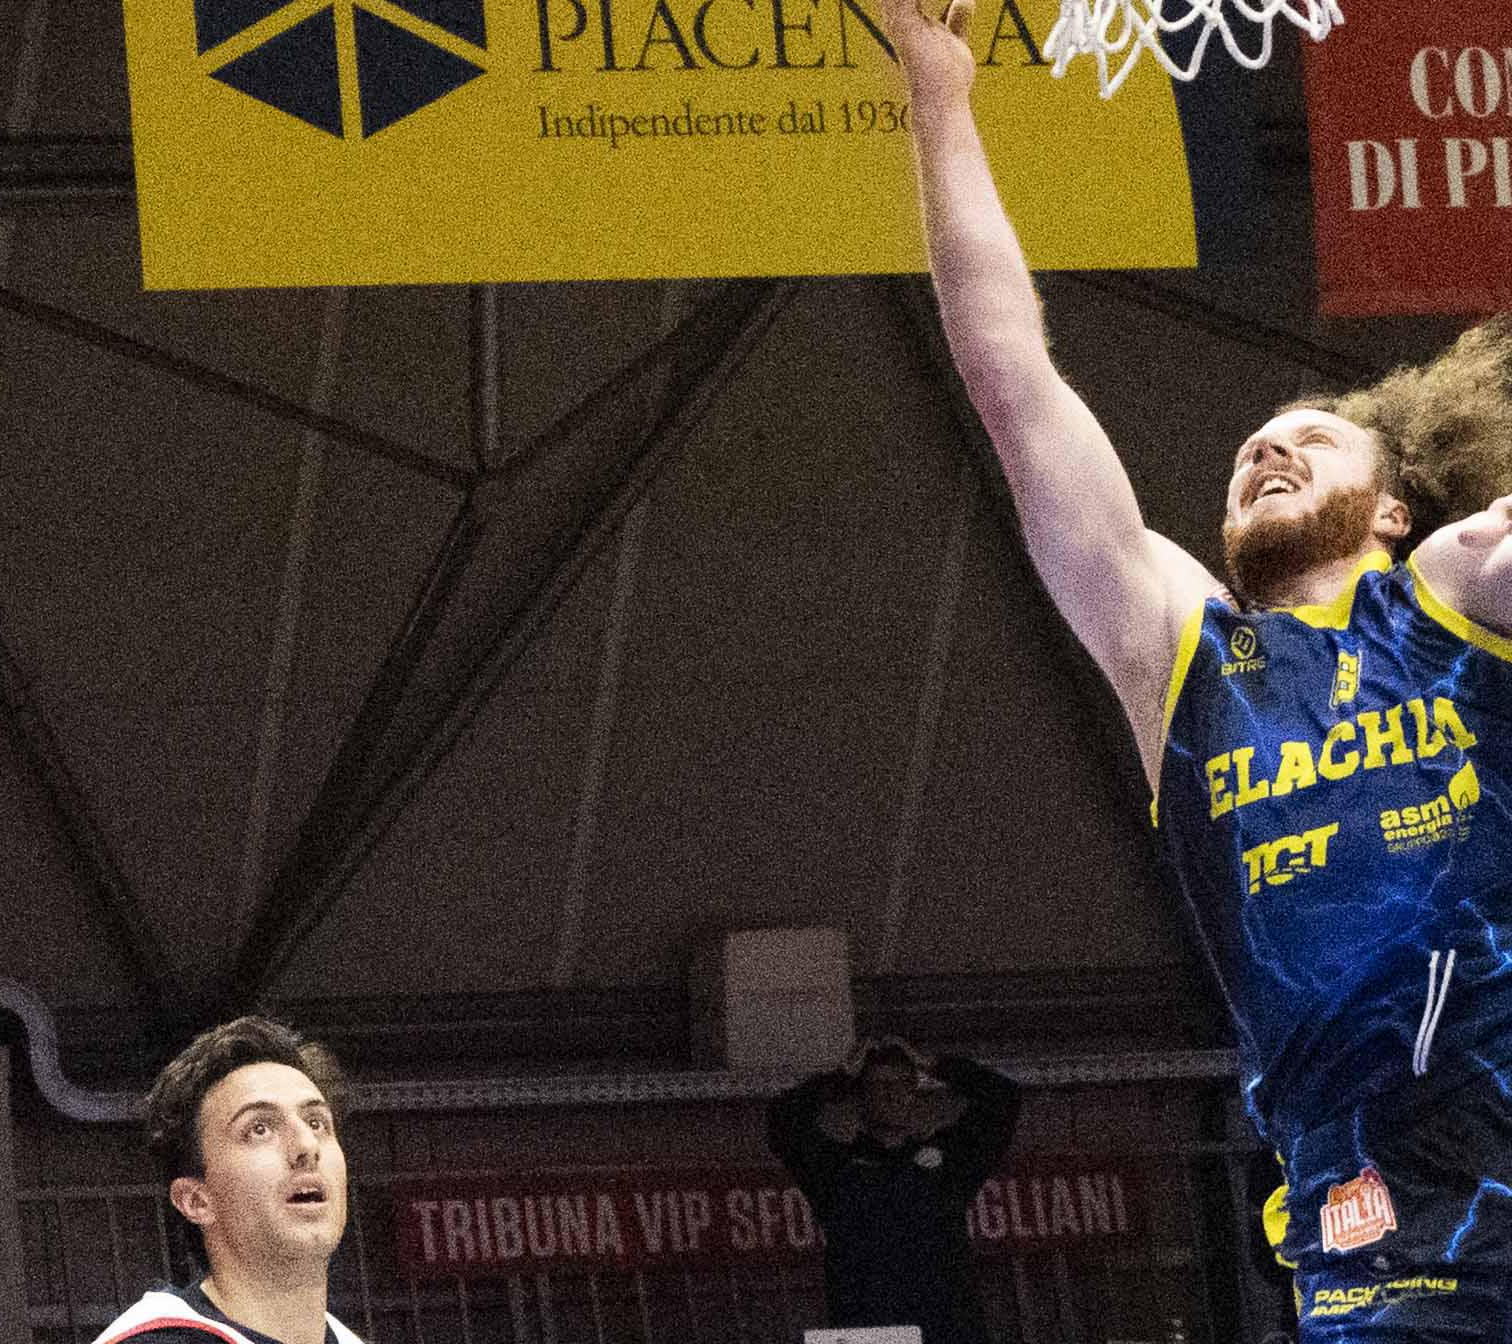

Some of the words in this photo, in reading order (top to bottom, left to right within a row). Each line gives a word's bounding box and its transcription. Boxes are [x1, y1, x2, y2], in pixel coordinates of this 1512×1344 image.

[537, 102, 768, 149] Indipendente
[776, 100, 828, 137] dal
[1346, 139, 1420, 212] DI
[1380, 795, 1450, 830] asm
[414, 1198, 623, 1260] TRIBUNA
[635, 1190, 711, 1250] VIP
[727, 1187, 827, 1250] SFO
